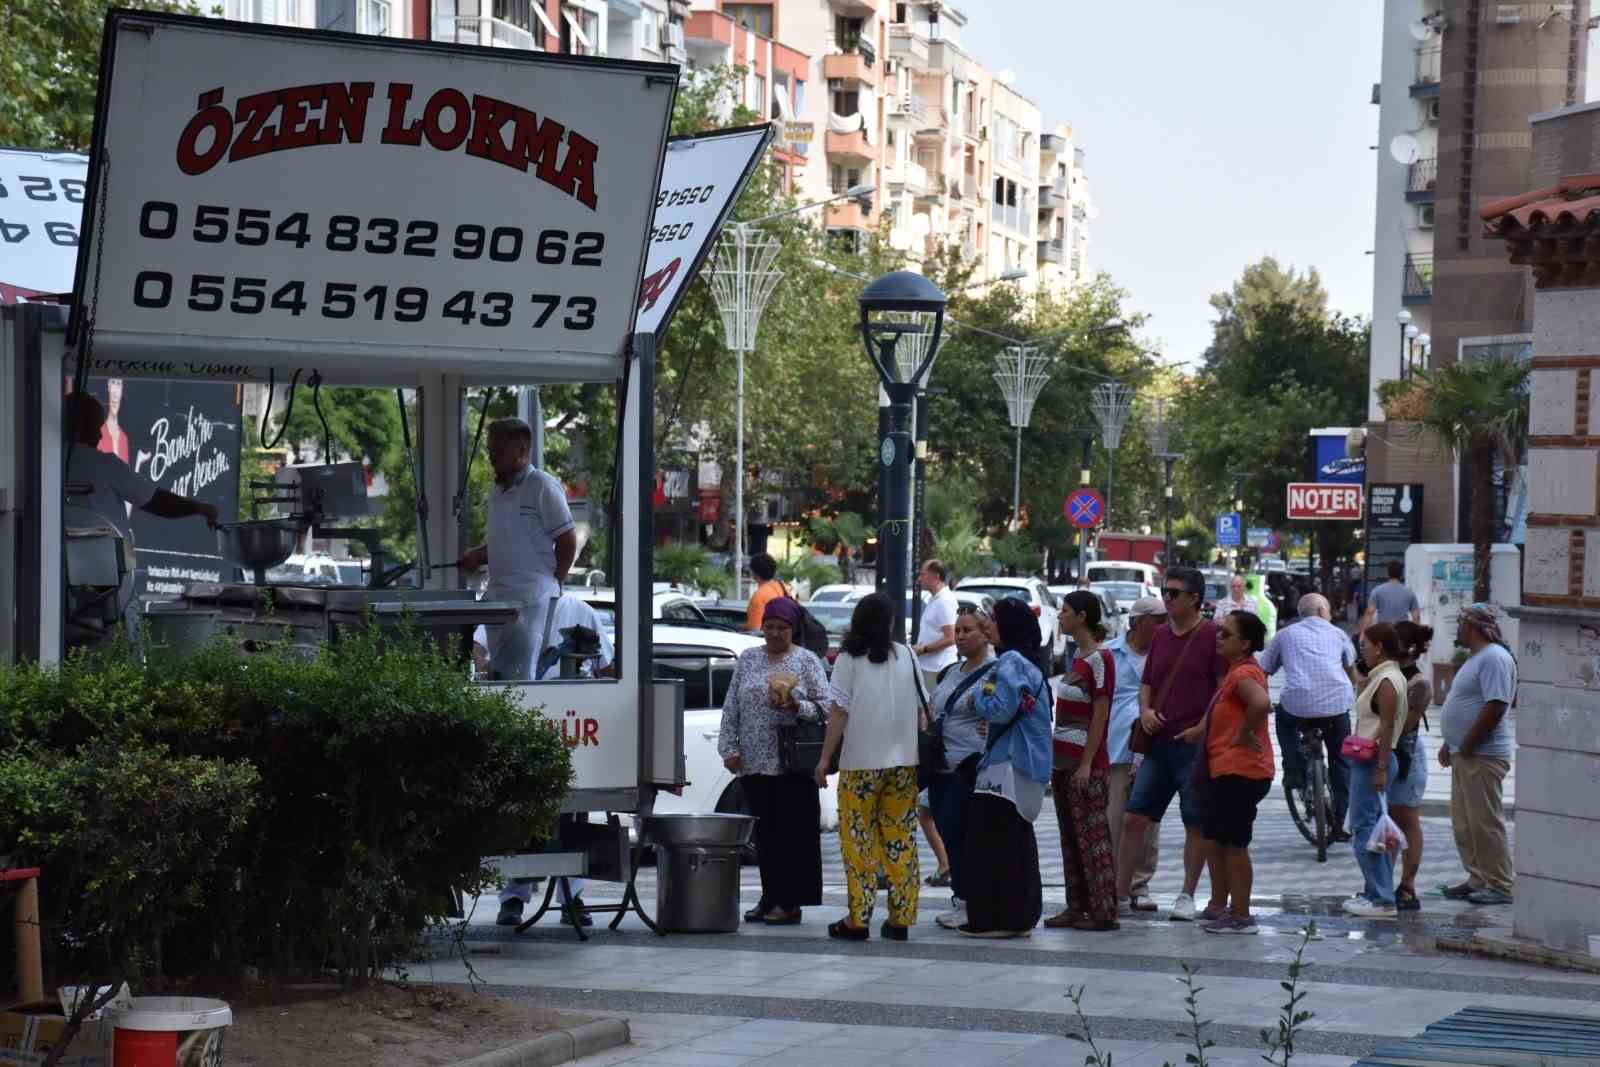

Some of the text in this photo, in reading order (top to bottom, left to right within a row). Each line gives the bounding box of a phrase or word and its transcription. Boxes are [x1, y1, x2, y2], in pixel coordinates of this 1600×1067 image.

[176, 82, 598, 211] ÖZEN LOKMA
[139, 201, 605, 266] 0 554 832 90 62
[133, 271, 596, 330] 0 554 519 43 73
[1220, 517, 1232, 533] P
[1290, 489, 1358, 511] NOTER
